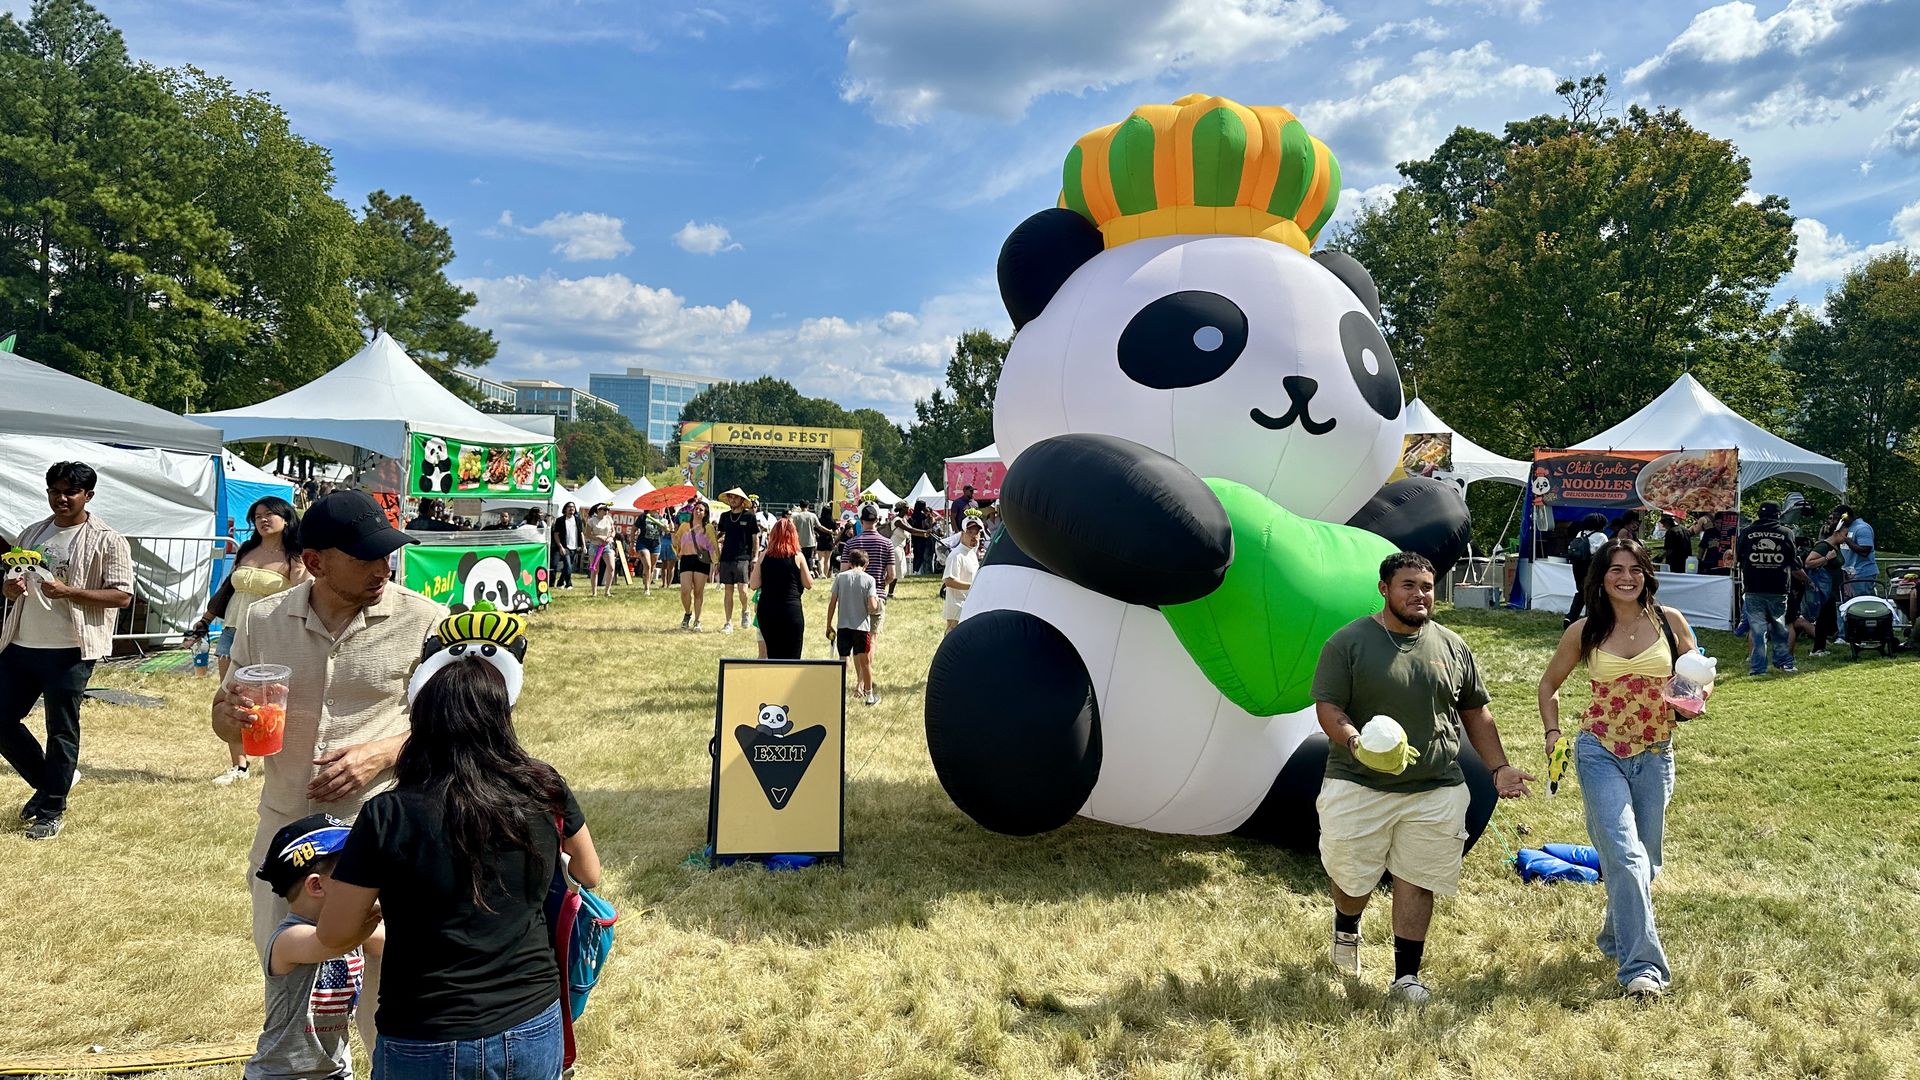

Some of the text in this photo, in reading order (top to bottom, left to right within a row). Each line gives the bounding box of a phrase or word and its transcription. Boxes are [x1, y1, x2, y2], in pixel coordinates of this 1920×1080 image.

[788, 432, 829, 443] FEST
[1566, 461, 1628, 478] Chili Garlic
[1561, 479, 1633, 491] NOODLES
[1747, 531, 1785, 541] CERVEZA
[1749, 552, 1785, 563] CITO
[433, 570, 457, 597] Ball
[754, 744, 807, 762] EXIT
[292, 841, 316, 868] 48
